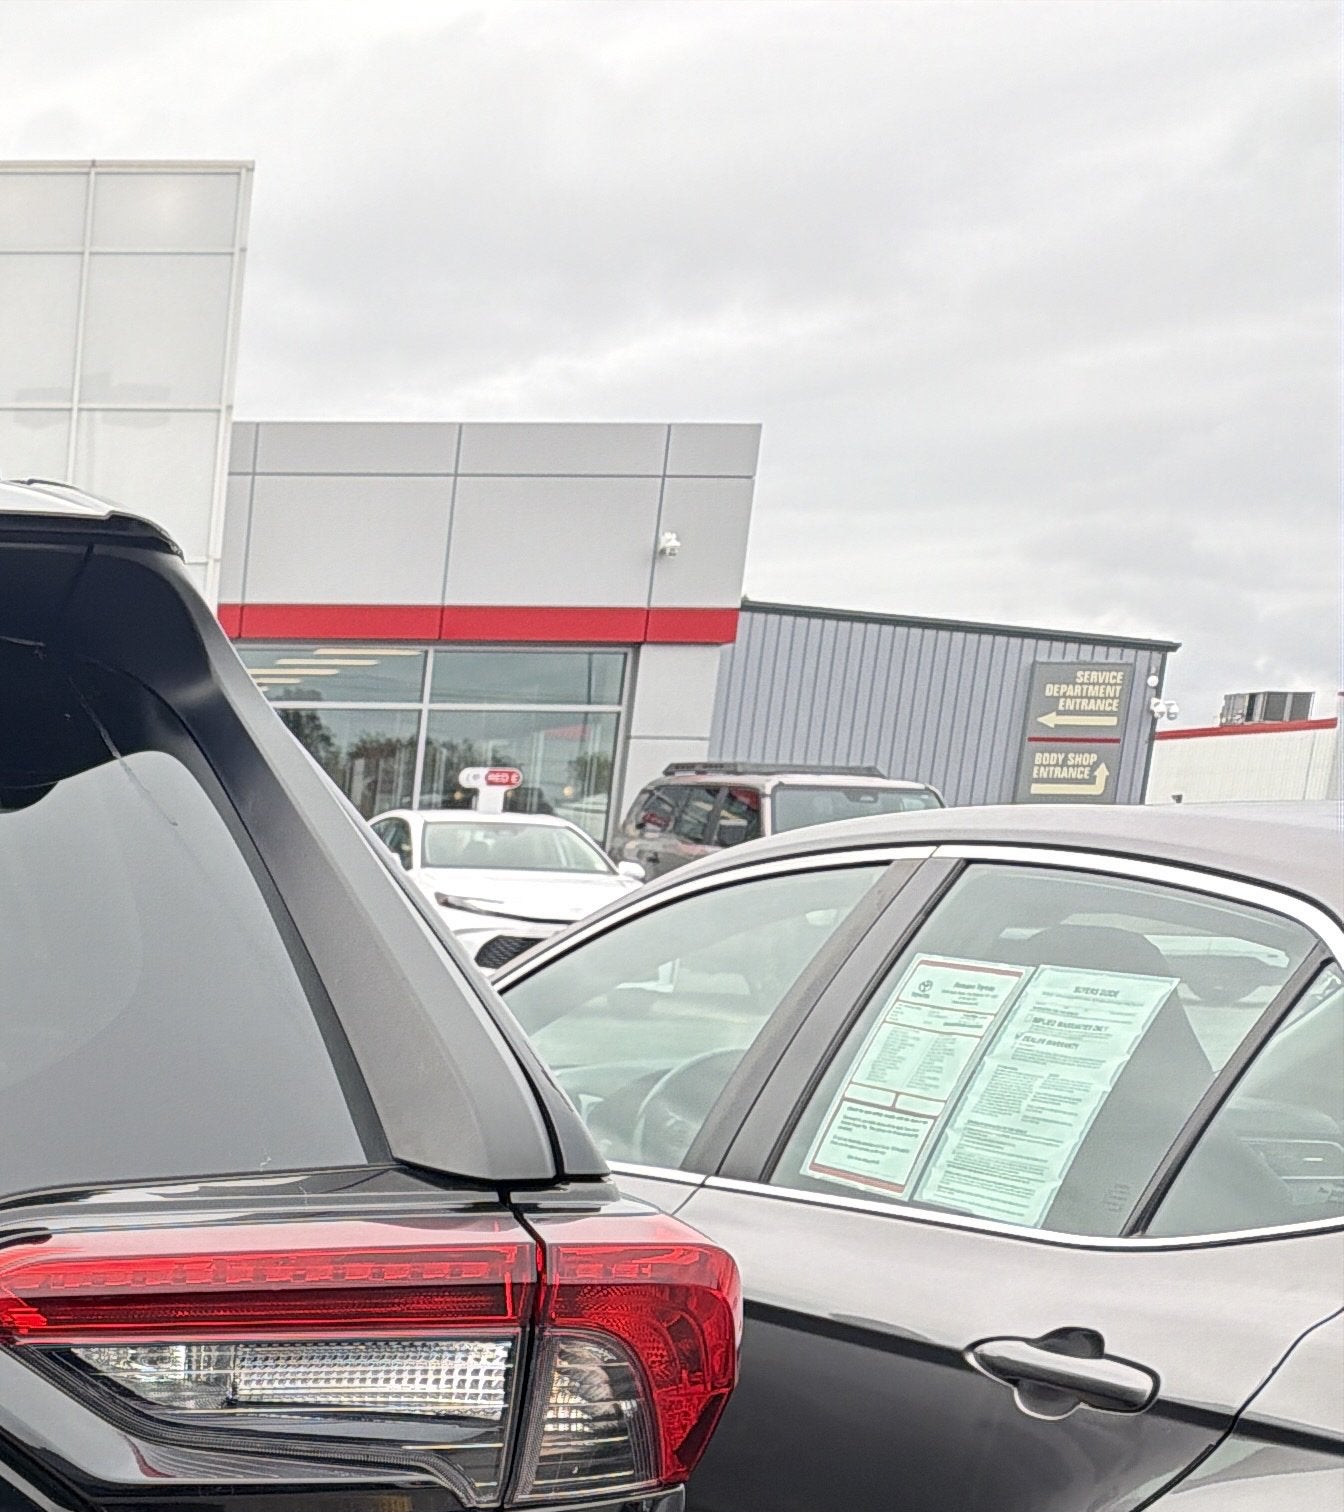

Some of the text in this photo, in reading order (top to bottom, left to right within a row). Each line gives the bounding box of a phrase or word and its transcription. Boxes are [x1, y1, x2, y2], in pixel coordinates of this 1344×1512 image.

[1076, 671, 1124, 683] SERVICE
[1045, 684, 1122, 697] DEPARTMENT
[1058, 698, 1120, 711] ENTRANCE
[1034, 752, 1098, 766] BODY SHOP
[1032, 766, 1091, 779] ENTRANCE
